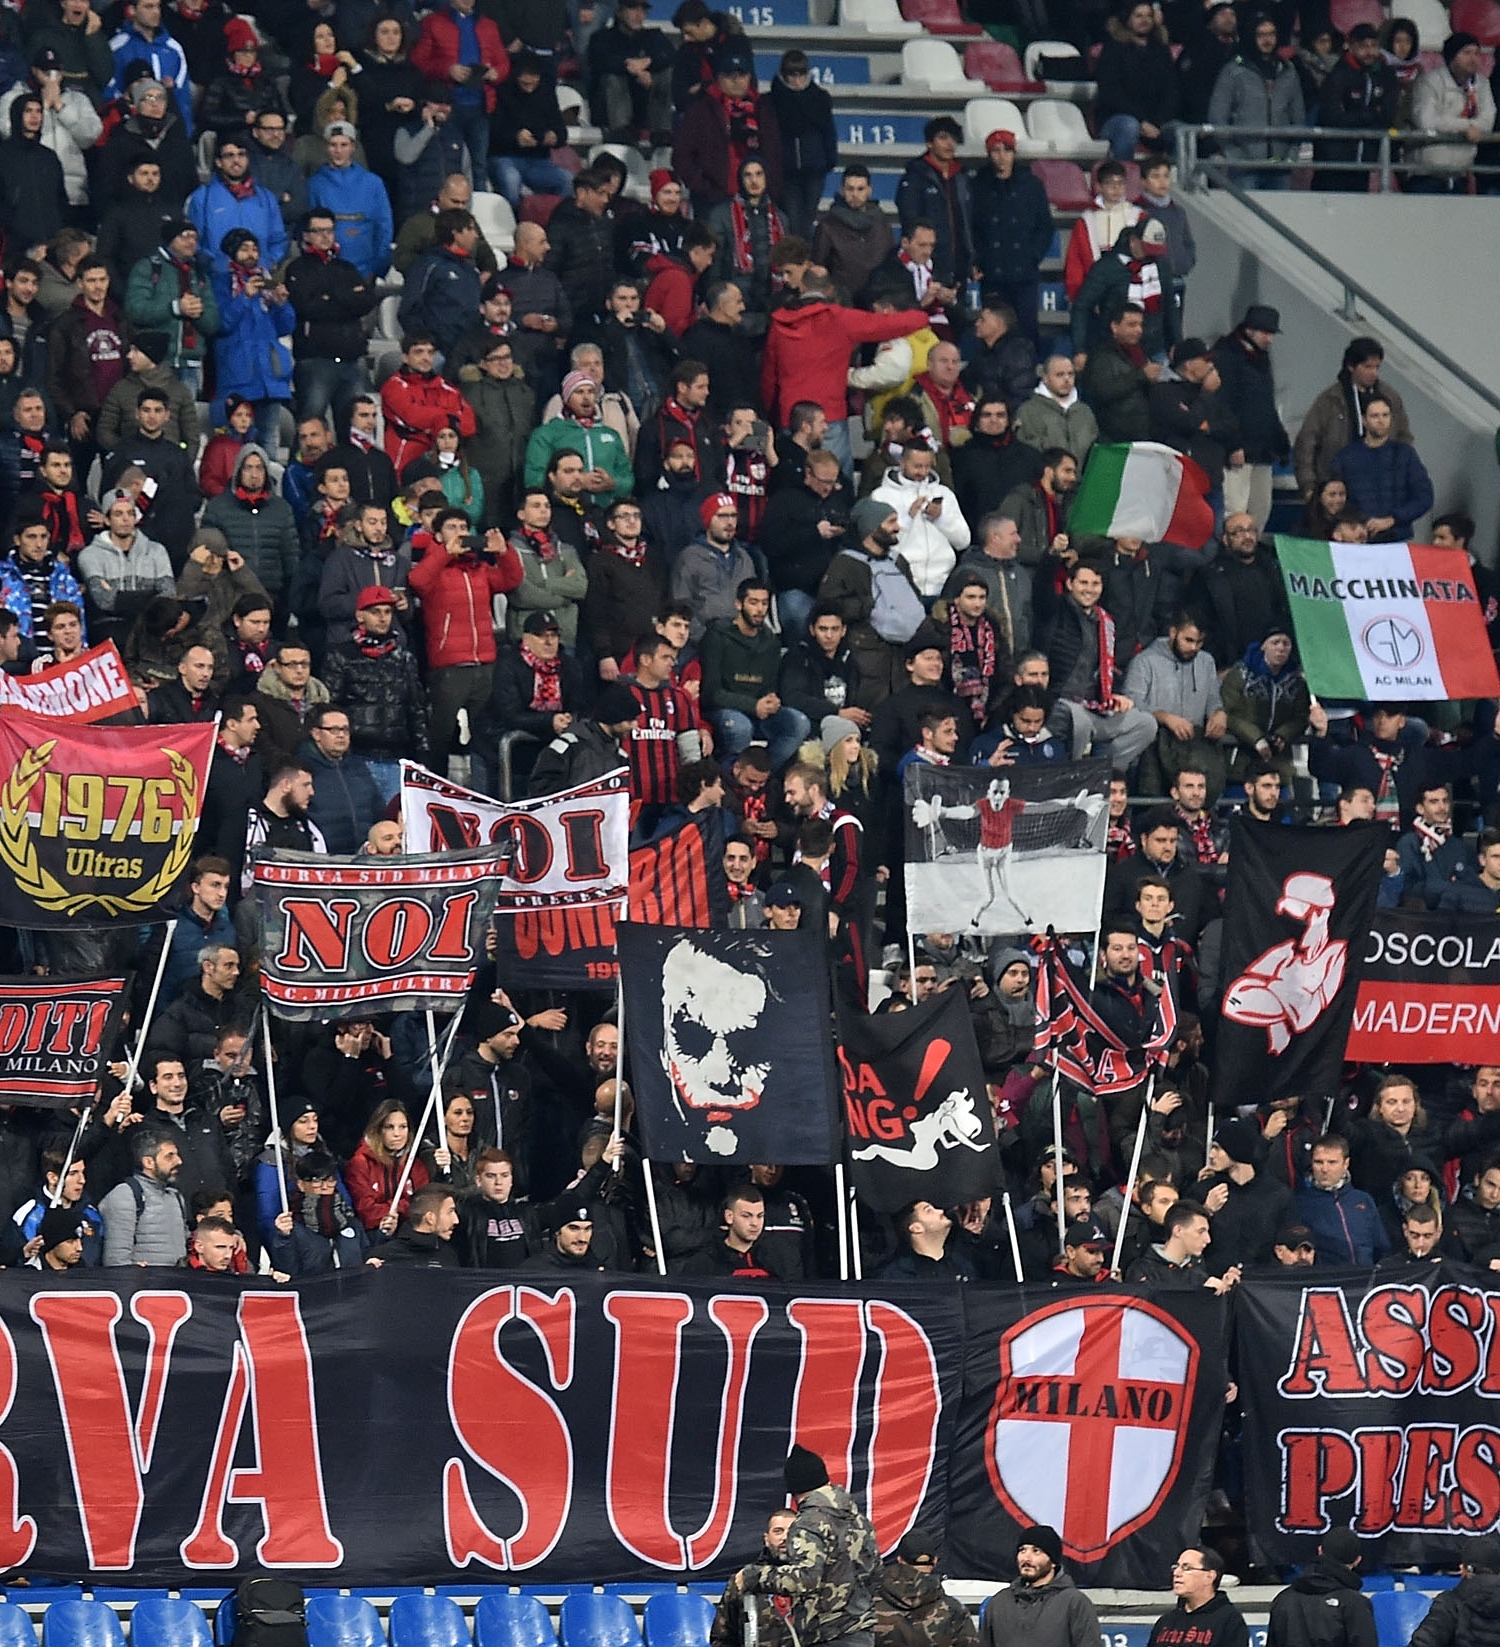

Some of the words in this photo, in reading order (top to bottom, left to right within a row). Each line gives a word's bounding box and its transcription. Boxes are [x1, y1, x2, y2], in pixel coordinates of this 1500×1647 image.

[748, 7, 774, 25] 15
[850, 125, 864, 145] H
[871, 125, 896, 145] 13
[1288, 571, 1478, 602] MACCHINATA
[1375, 676, 1392, 686] AC
[1395, 676, 1433, 686] MILAN
[40, 772, 176, 843] 1976
[426, 803, 610, 884] NOI
[65, 847, 144, 880] Ultras
[262, 867, 343, 884] CURVA
[359, 869, 404, 884] SUD
[275, 890, 480, 972] NOI
[1353, 1000, 1500, 1034] MADERN
[6, 1056, 98, 1074] MILANO
[1277, 1283, 1500, 1400] ASS
[1011, 1381, 1173, 1424] MILANO
[443, 1285, 943, 1572] SUD
